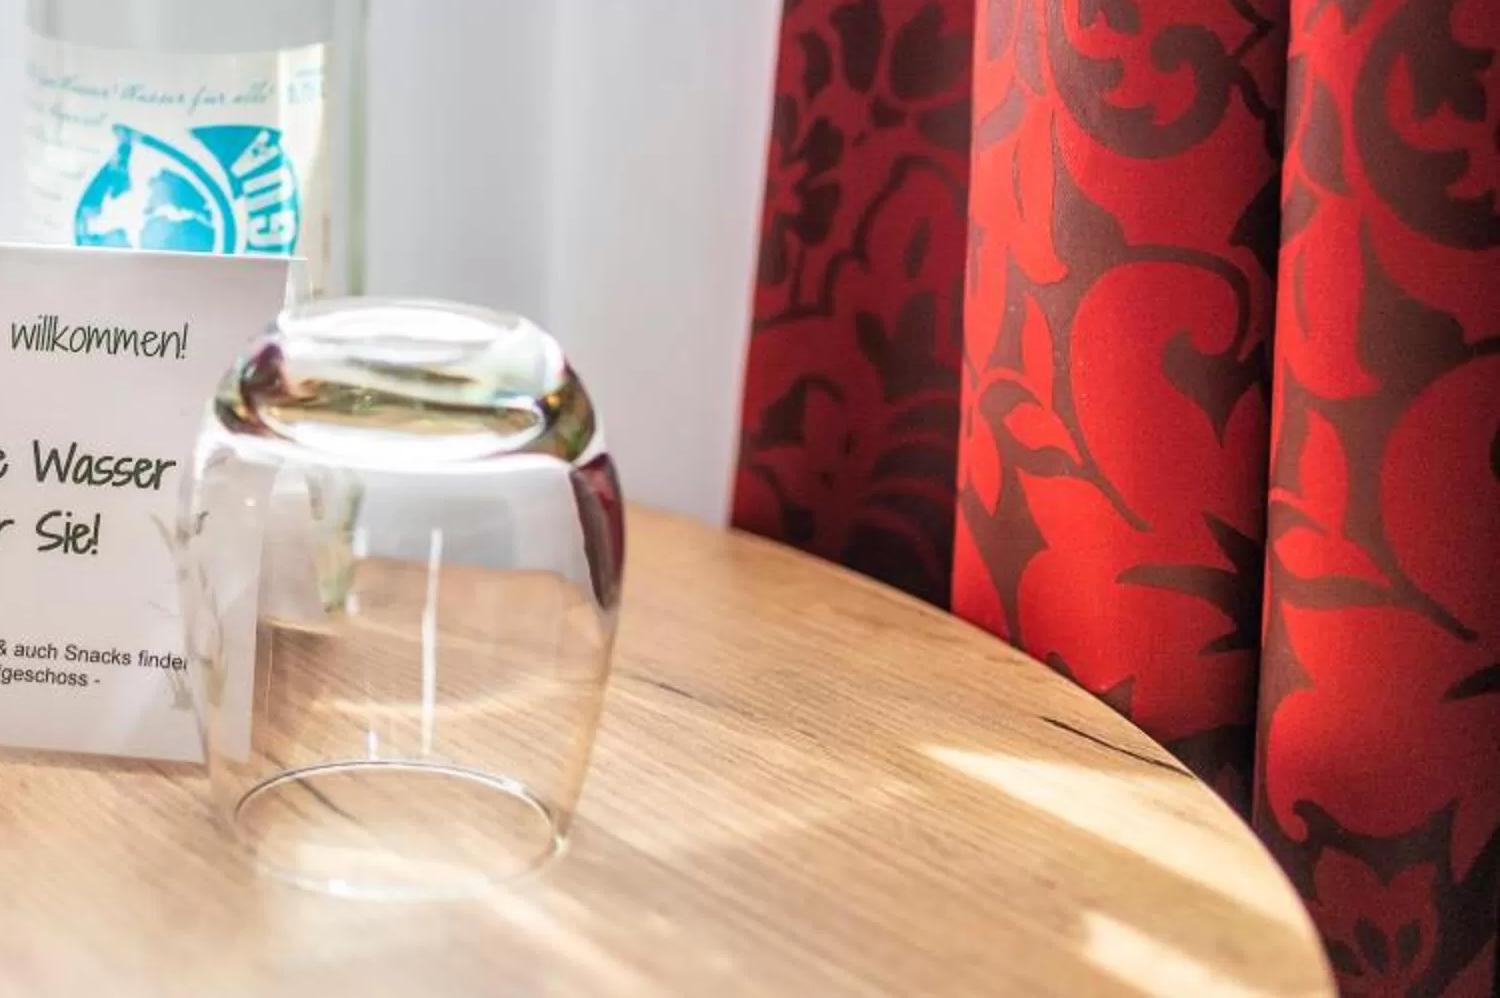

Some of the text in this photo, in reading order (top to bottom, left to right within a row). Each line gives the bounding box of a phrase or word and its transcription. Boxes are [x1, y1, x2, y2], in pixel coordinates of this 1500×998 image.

[11, 314, 188, 359] willkommen!
[33, 439, 176, 490] Wasser
[35, 510, 100, 555] Sie!
[13, 643, 57, 660] auch
[65, 644, 132, 666] Snacks
